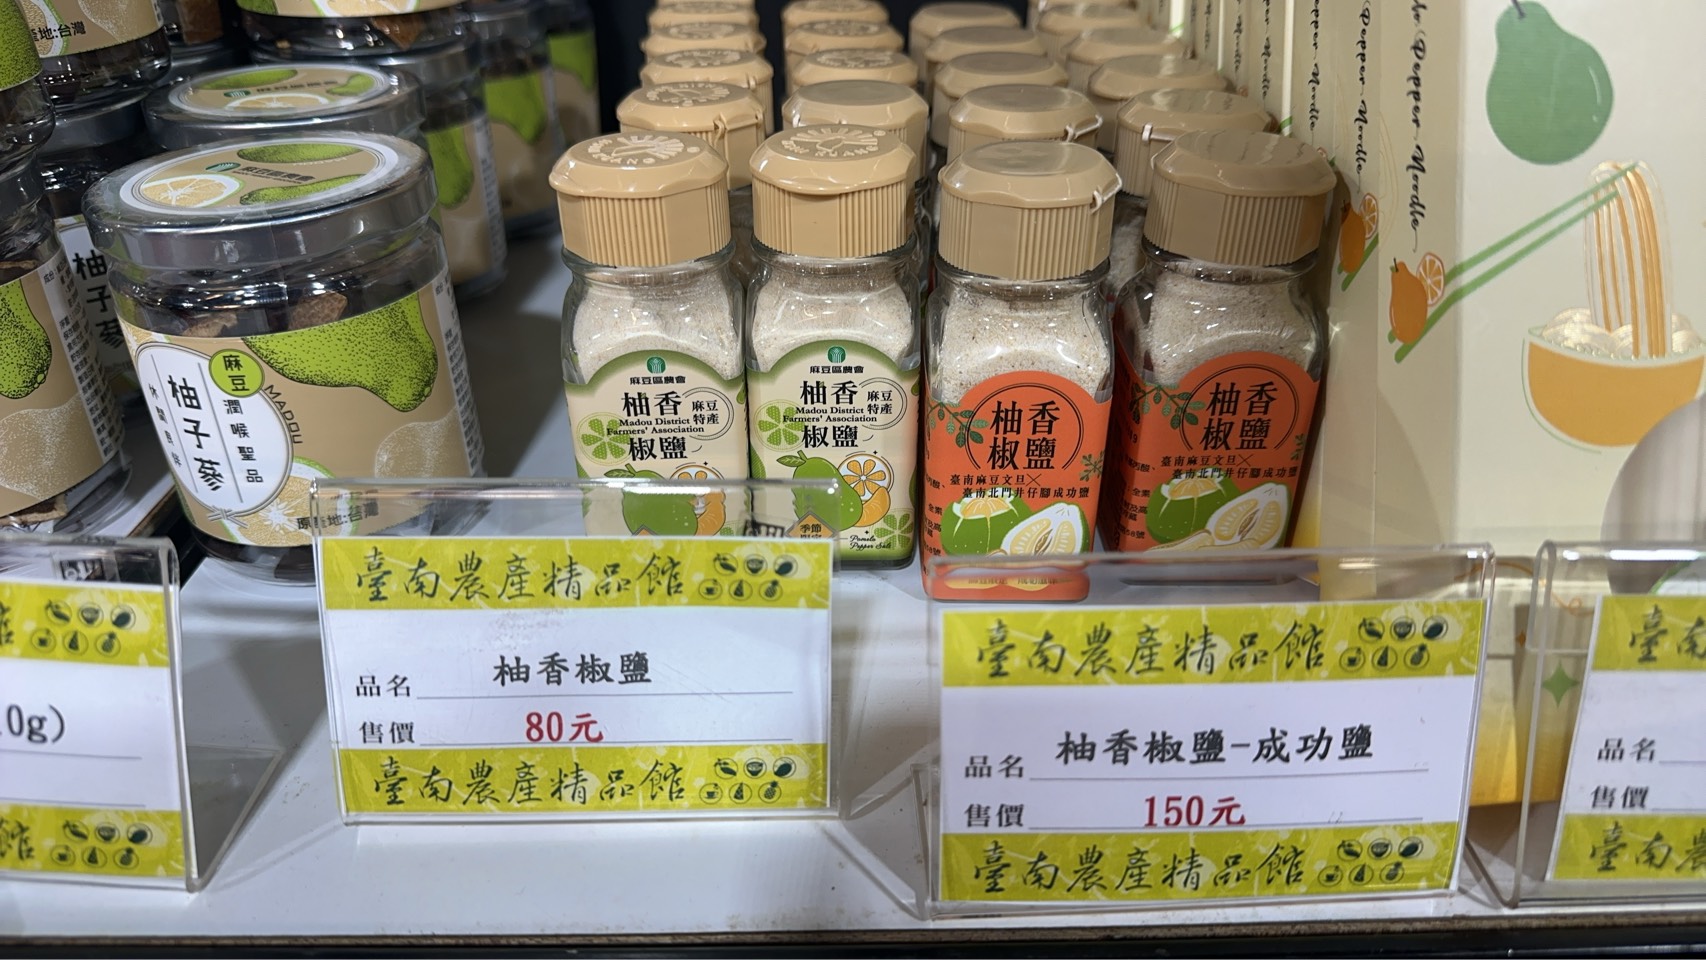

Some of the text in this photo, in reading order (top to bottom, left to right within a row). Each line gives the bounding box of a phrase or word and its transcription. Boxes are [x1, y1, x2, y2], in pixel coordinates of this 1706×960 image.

[1310, 0, 1320, 51] epper
[223, 354, 250, 393] 麻豆
[629, 375, 686, 385] 麻豆區農會
[809, 366, 865, 374] 麻豆區農會
[621, 391, 683, 418] 柚香
[691, 400, 719, 412] 麻豆
[800, 380, 859, 406] 柚香
[867, 390, 893, 402] 麻豆
[1206, 381, 1278, 416] 柚香
[265, 384, 304, 445] MADOU
[619, 417, 690, 427] Madou District
[693, 413, 720, 425] 特產
[783, 414, 877, 423] Farmers' Association
[796, 406, 864, 415] Madou District
[867, 403, 893, 415] 特產
[989, 400, 1061, 435] 柚香
[167, 374, 225, 492] 柚子蔘
[223, 398, 264, 484] 潤喉聖品
[606, 426, 705, 436] Farmers' Association
[801, 425, 859, 449] 椒鹽
[1199, 418, 1272, 451] 椒鹽
[628, 436, 688, 462] 椒鹽
[987, 436, 1057, 471] 椒鹽
[962, 487, 1090, 499] 臺南北門井仔腳成功鹽
[800, 523, 822, 534] 季節
[355, 547, 685, 603] 臺南農產精品館
[975, 618, 1326, 680] 臺南農產精品館
[355, 651, 652, 698] 品名 柚香椒鹽
[0, 703, 66, 744] 0g)
[359, 711, 604, 744] 售價 80元
[963, 723, 1375, 780] 品名 柚香椒鹽-成功鹽
[1597, 737, 1656, 763] 品名
[373, 756, 685, 806] 臺南農產精品館
[963, 795, 1247, 829] 售價 150元
[1590, 785, 1650, 810] 售價
[973, 840, 1306, 894] 臺南農產精品館
